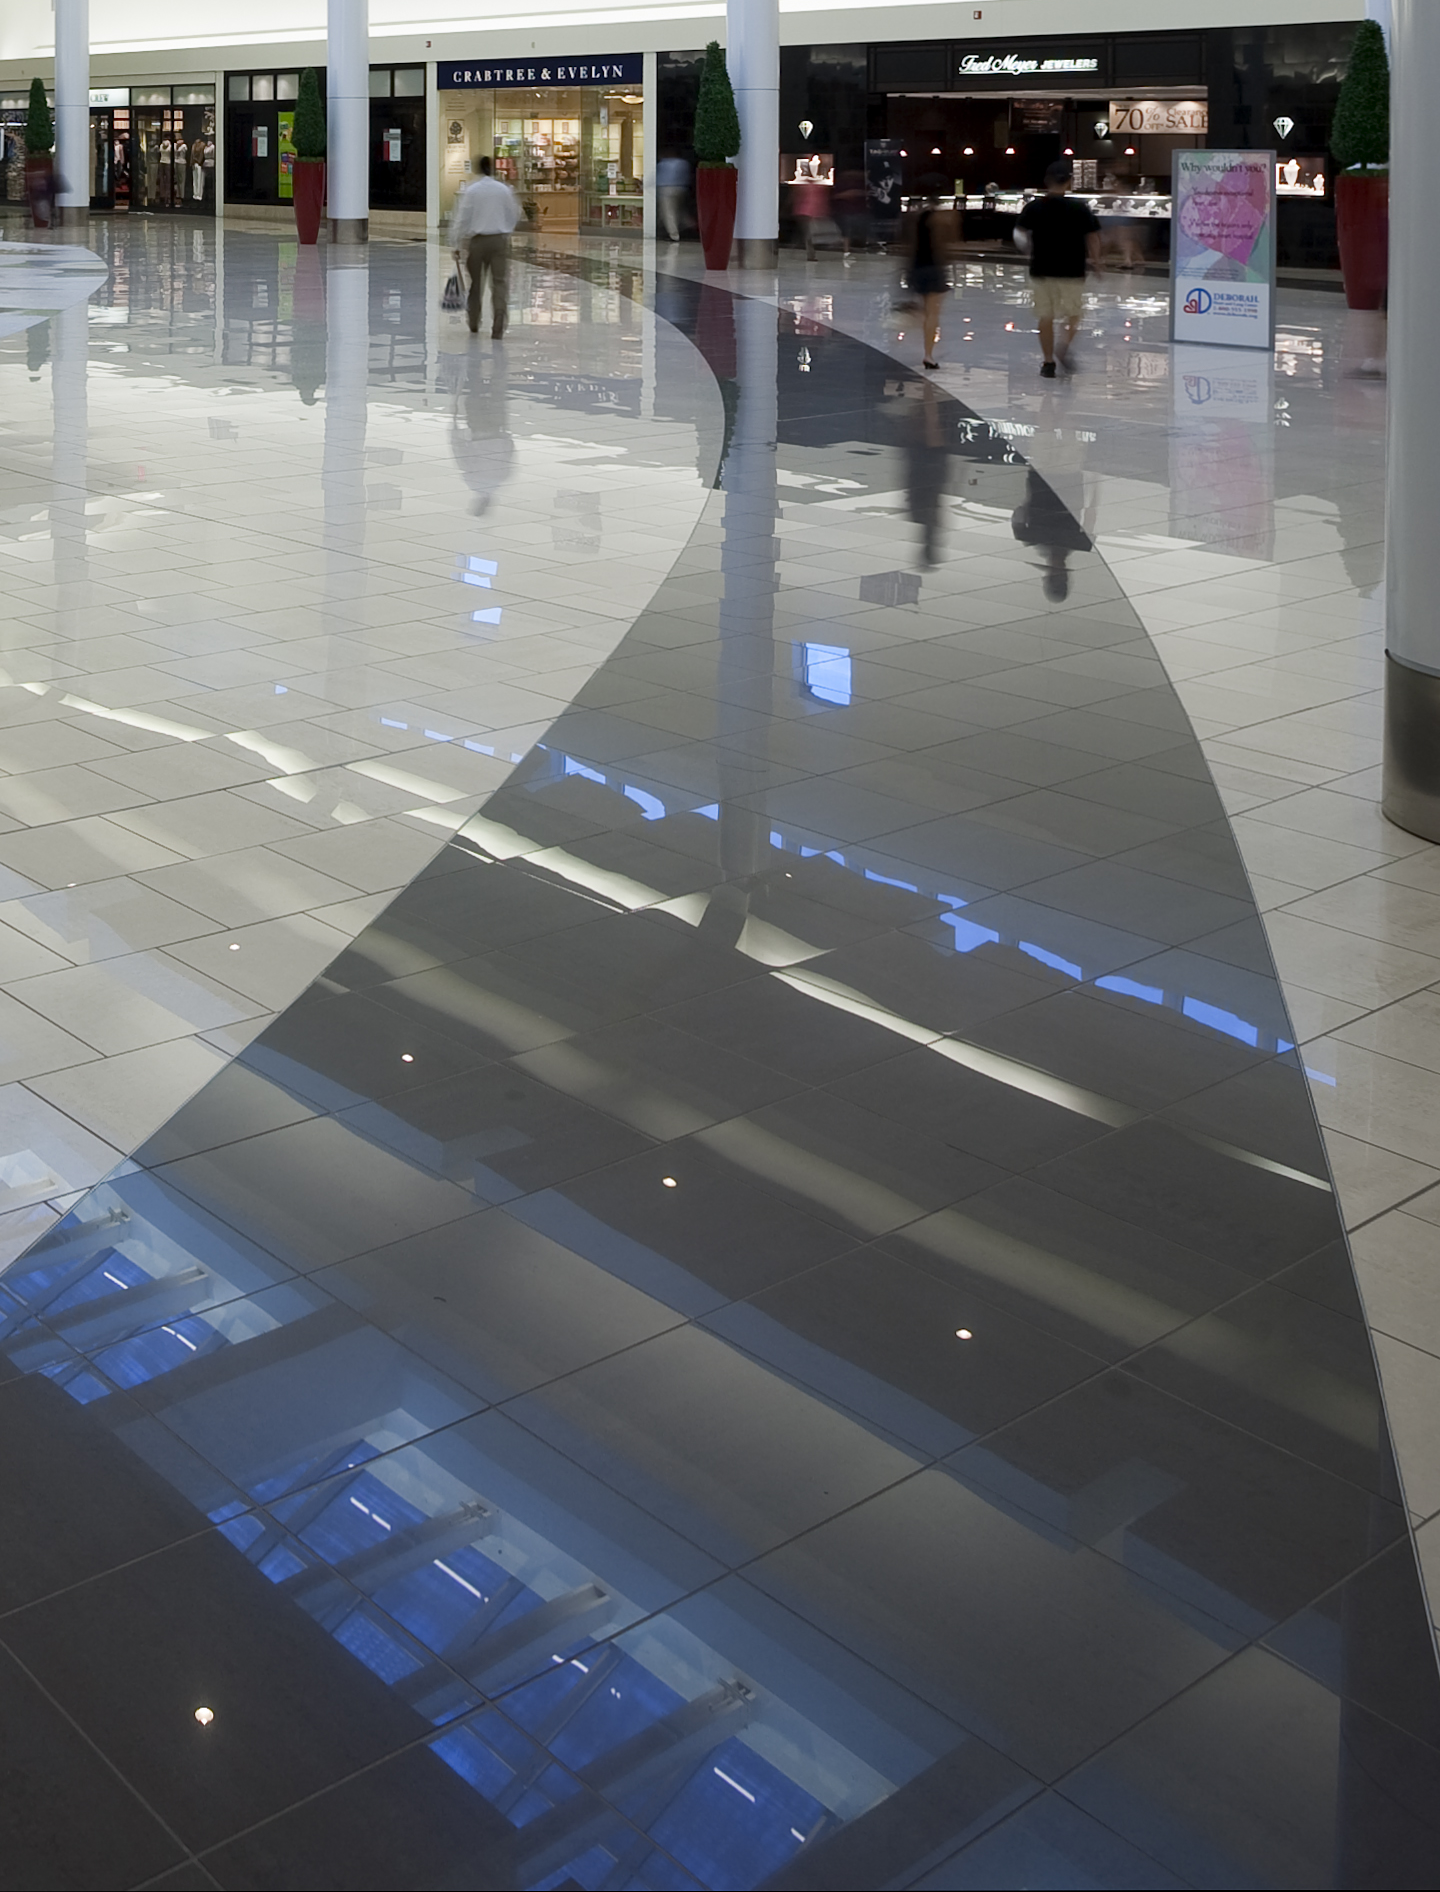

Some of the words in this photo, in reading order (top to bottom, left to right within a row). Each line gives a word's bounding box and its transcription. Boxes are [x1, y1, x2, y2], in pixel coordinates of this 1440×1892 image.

[453, 68, 536, 83] CRABTREE
[540, 67, 552, 81] &
[557, 64, 624, 80] EVELYN
[958, 54, 995, 73] Fred
[992, 54, 1038, 76] Meyer
[1040, 59, 1098, 69] JEWELERS
[1114, 108, 1144, 131] 70
[1181, 162, 1203, 174] Why
[1204, 163, 1242, 173] wouldn't
[1244, 163, 1267, 175] you?
[1213, 293, 1259, 303] DEBORAH
